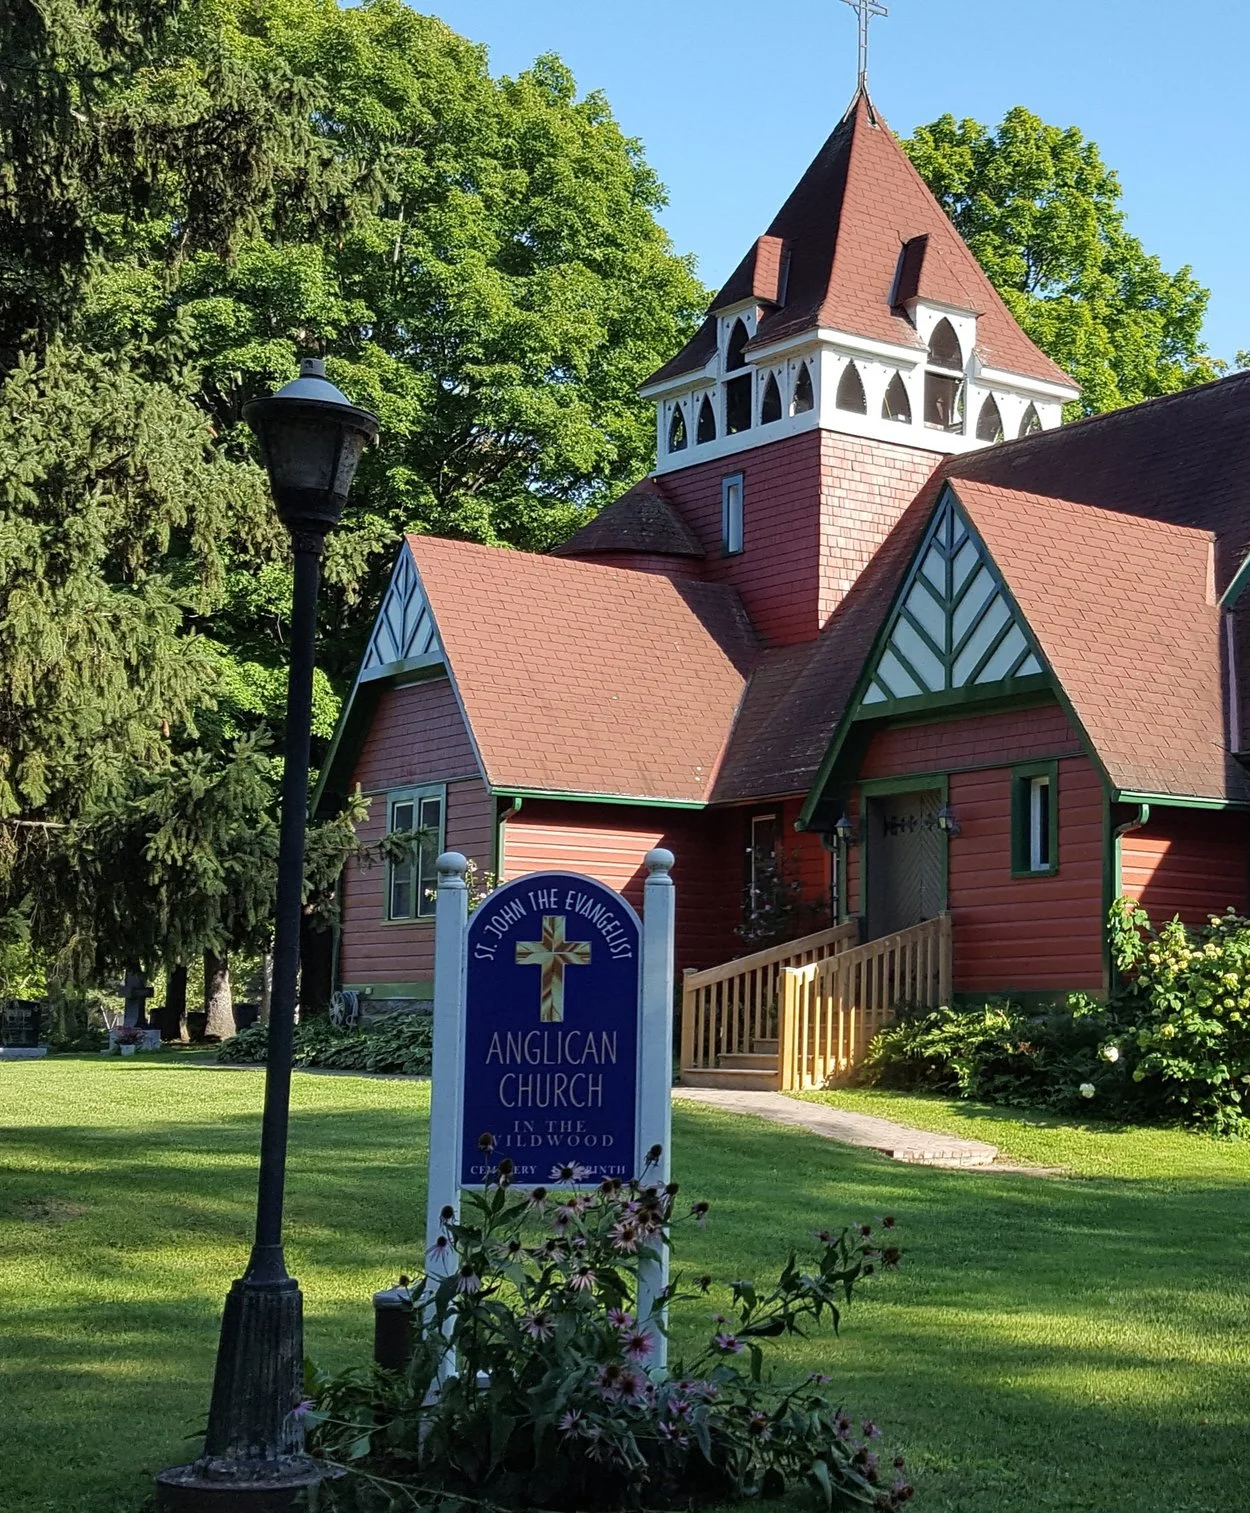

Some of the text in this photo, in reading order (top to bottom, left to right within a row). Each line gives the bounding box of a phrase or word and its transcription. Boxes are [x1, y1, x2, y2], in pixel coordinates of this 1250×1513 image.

[474, 888, 632, 961] ST. JOHN THE EVANGELIST
[486, 1030, 617, 1065] ANGLICAN
[499, 1073, 602, 1108] CHURCH
[514, 1120, 586, 1133] IN THE
[470, 1165, 537, 1175] CEMERY
